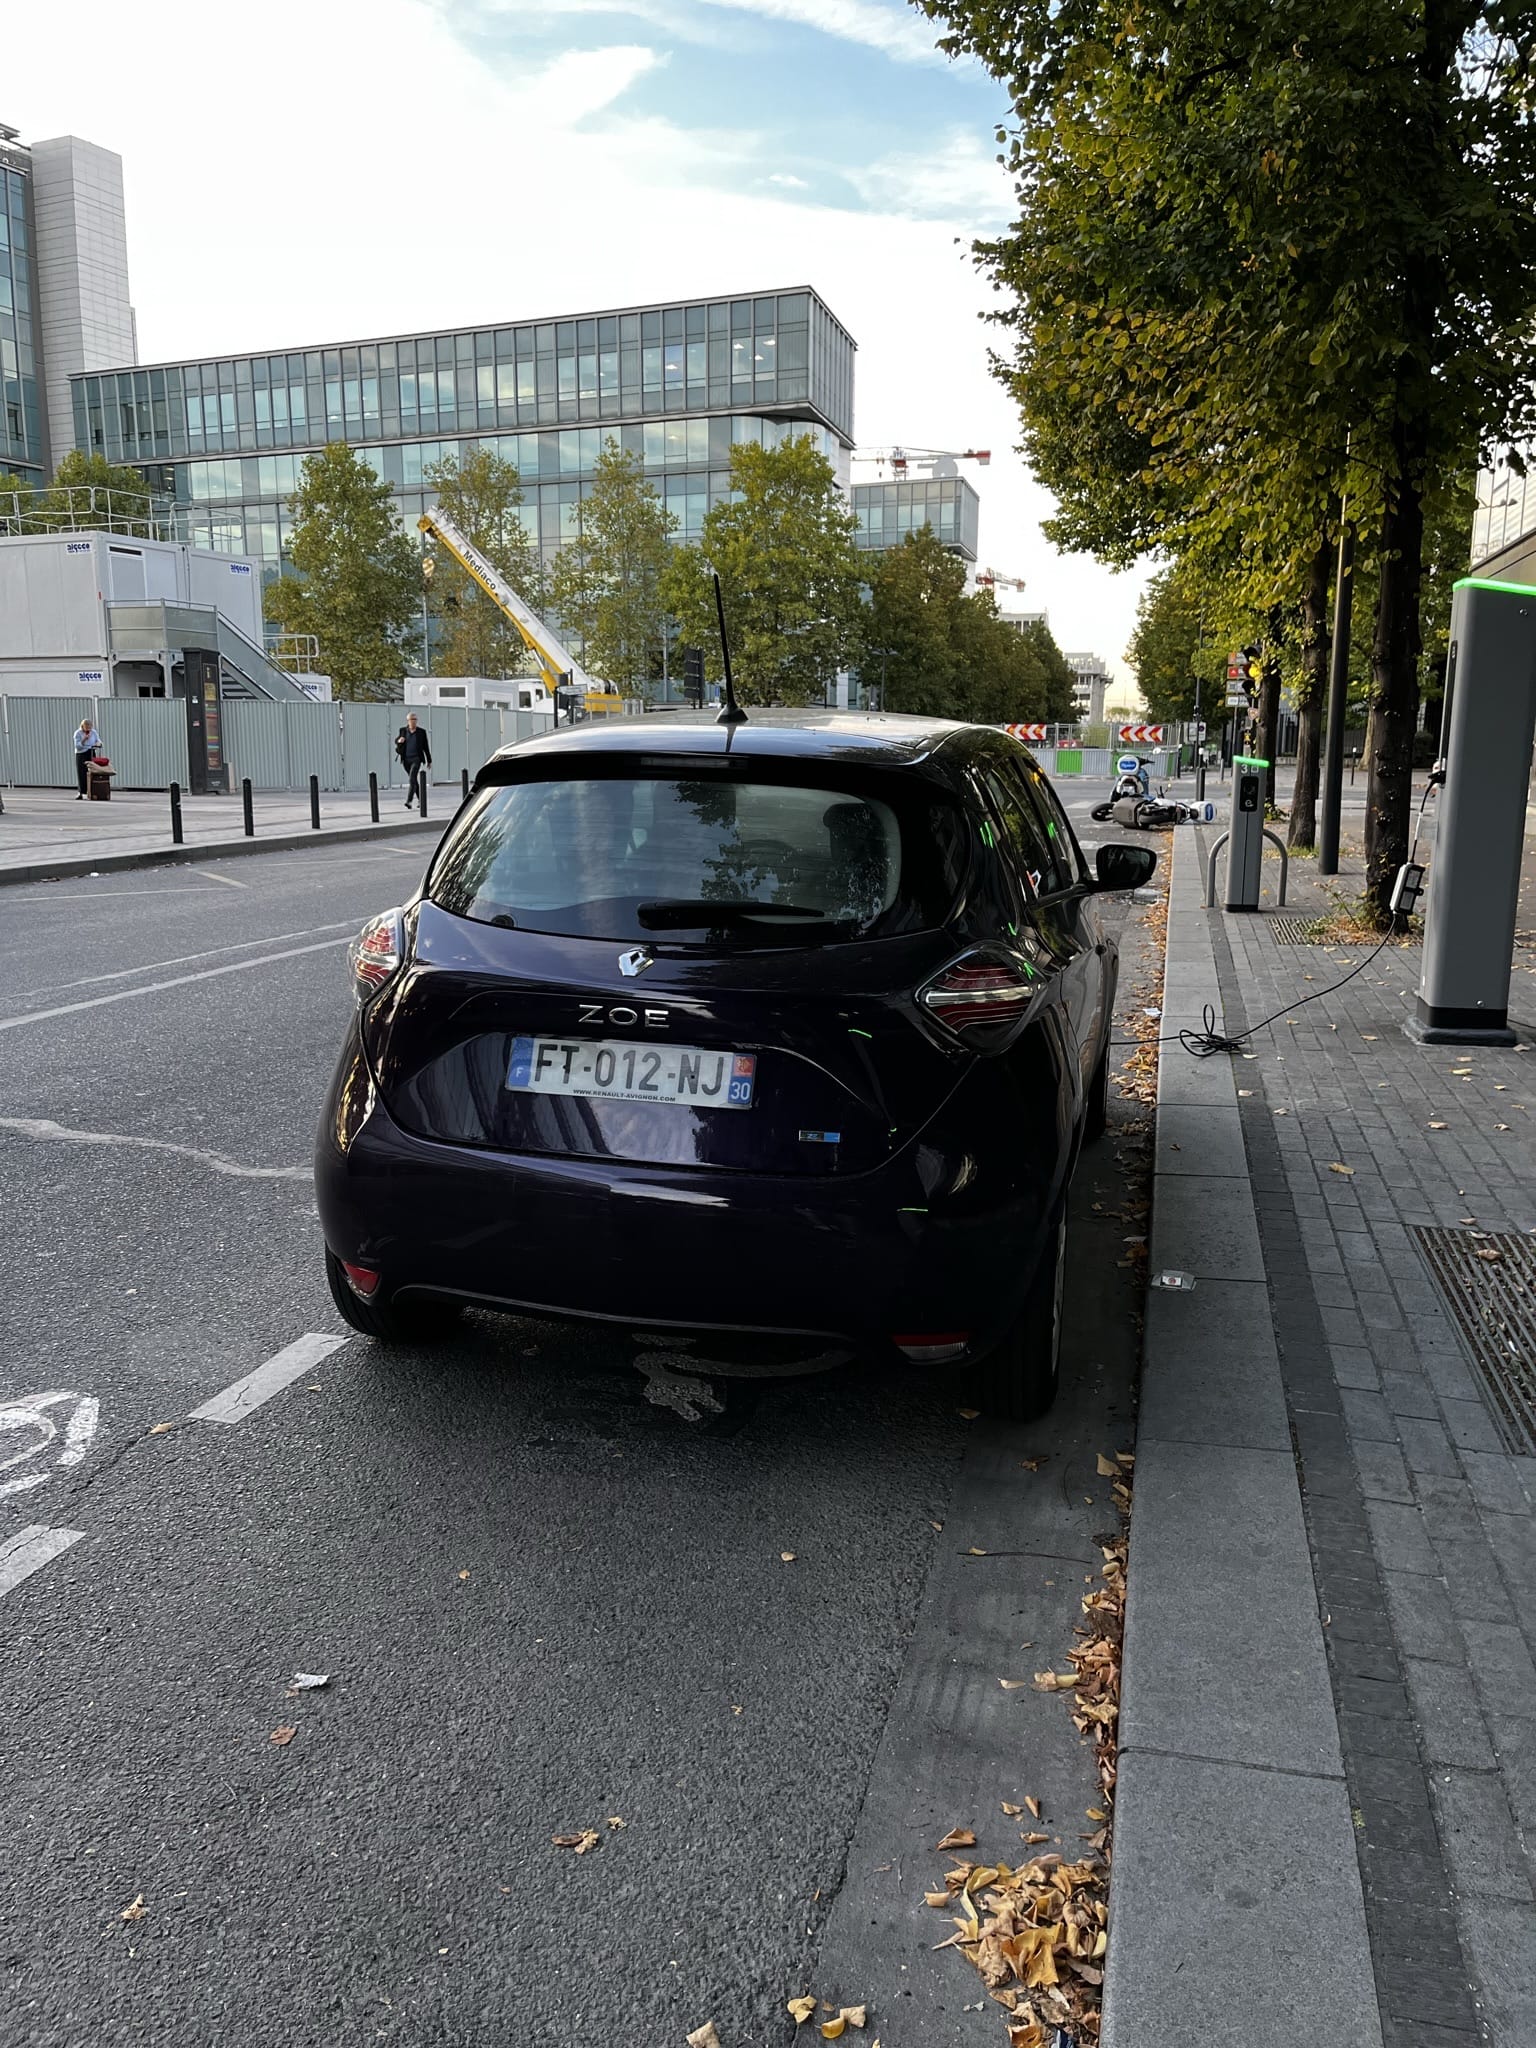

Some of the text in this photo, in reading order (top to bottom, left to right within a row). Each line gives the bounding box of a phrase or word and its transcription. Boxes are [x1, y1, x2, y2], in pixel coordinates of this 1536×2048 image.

[463, 550, 497, 590] Mediaco
[1241, 764, 1248, 774] 3
[578, 1004, 671, 1028] ZOE
[516, 1067, 523, 1077] F
[534, 1043, 724, 1096] FT-012-NJ
[573, 1089, 676, 1102] WWW.RENAULT-AVIGNON.COM
[731, 1081, 751, 1100] 30
